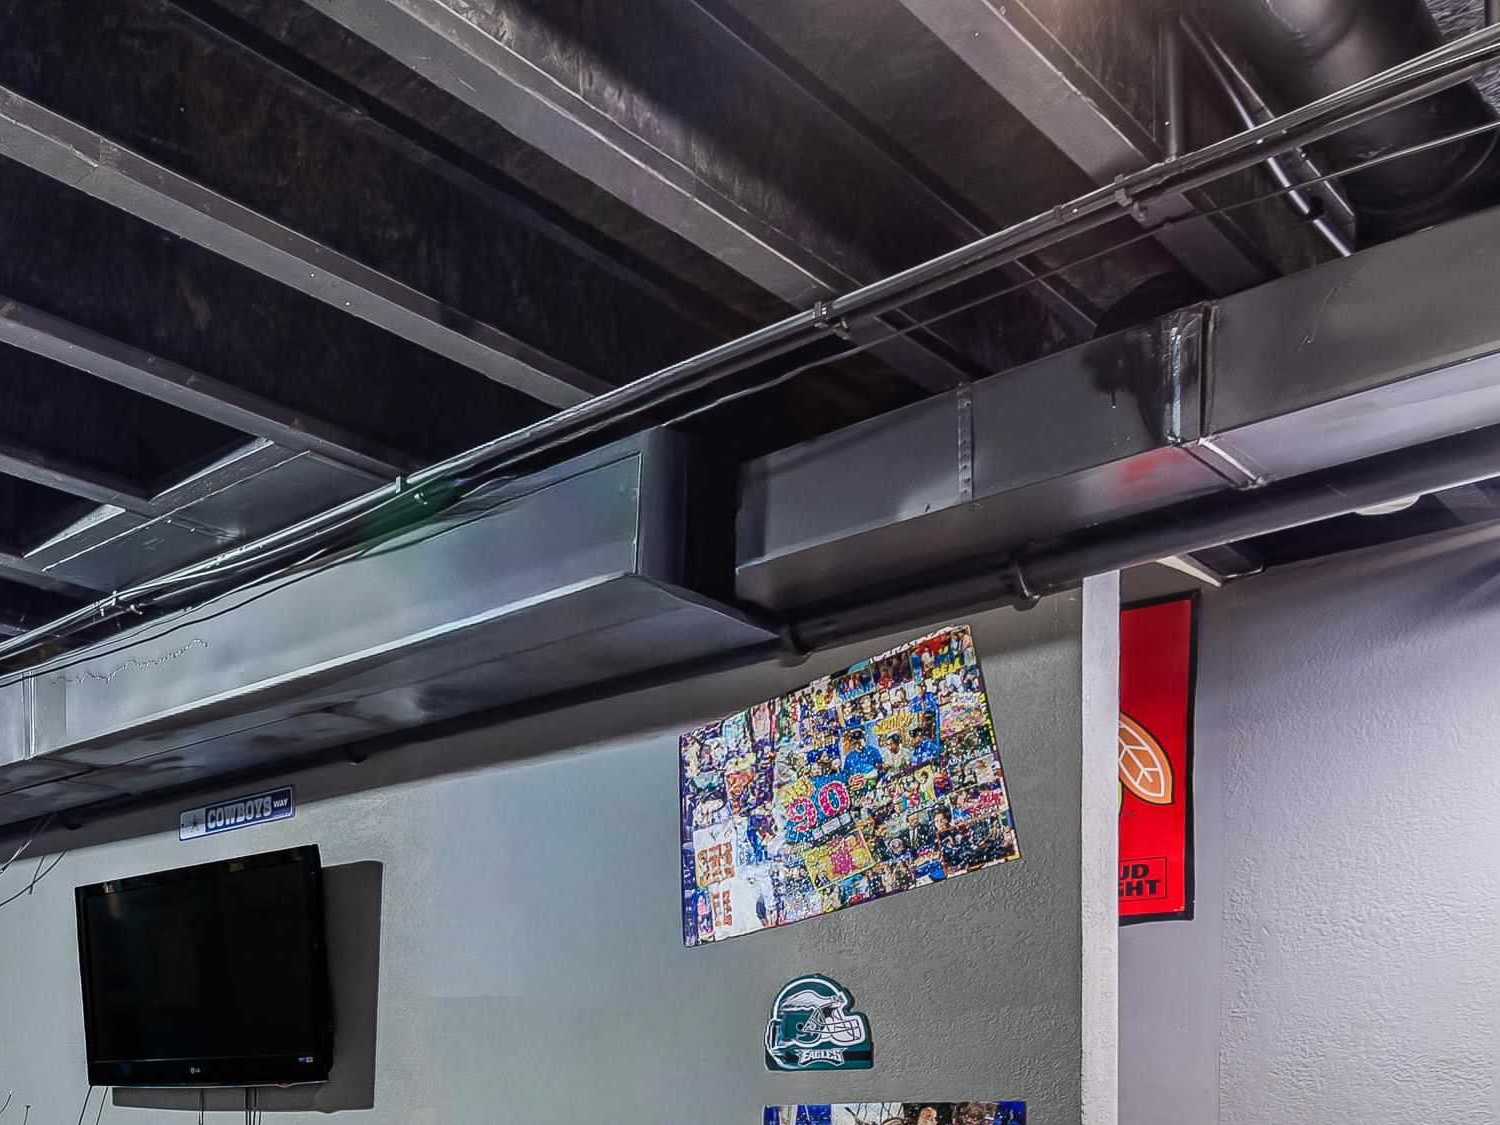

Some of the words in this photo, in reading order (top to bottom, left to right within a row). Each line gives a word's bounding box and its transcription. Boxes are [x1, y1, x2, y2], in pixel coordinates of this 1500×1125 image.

[207, 796, 272, 829] COWBOYS
[273, 798, 288, 808] WAY
[801, 1048, 843, 1062] EAGLES
